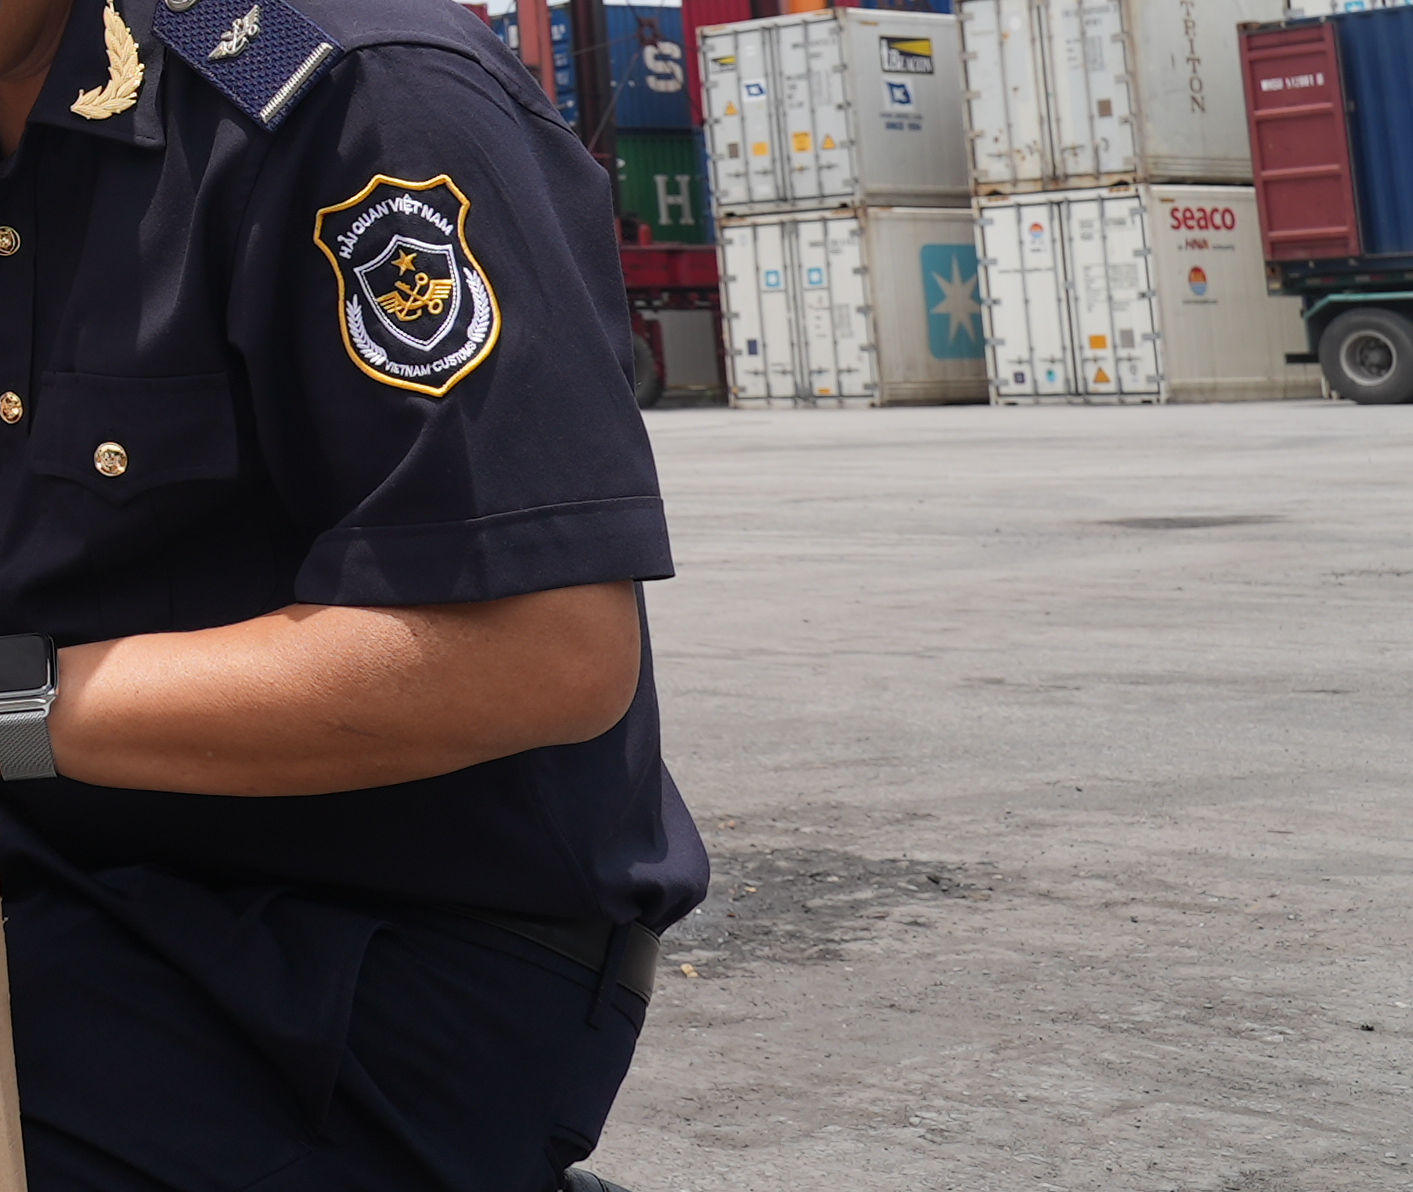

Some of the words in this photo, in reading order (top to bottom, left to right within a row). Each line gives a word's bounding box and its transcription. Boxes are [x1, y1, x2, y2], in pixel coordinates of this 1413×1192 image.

[1180, 0, 1208, 114] TRITON
[354, 201, 391, 235] QUAN
[388, 193, 423, 215] VIỆT
[421, 205, 454, 236] NAM
[654, 174, 695, 225] H
[1170, 207, 1235, 231] seaco
[384, 359, 431, 377] VIETNAM
[432, 341, 477, 372] CUSTOMS
